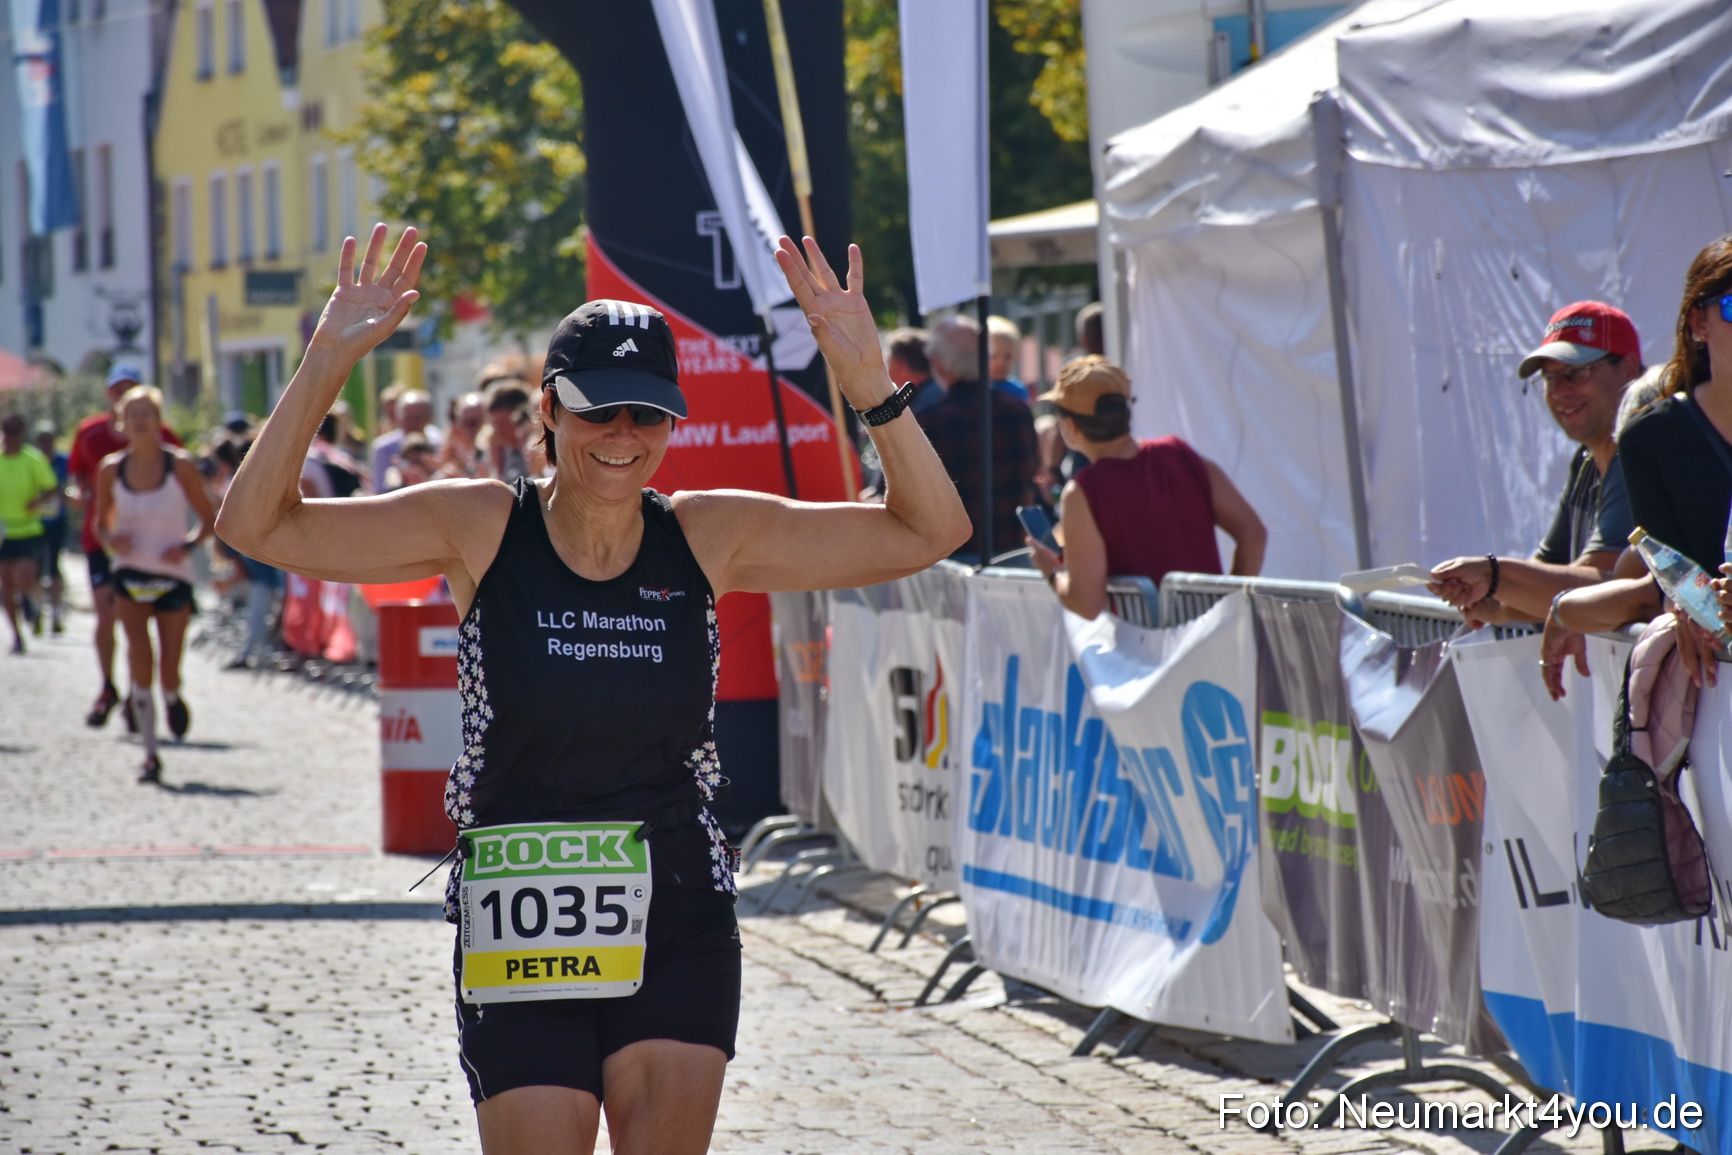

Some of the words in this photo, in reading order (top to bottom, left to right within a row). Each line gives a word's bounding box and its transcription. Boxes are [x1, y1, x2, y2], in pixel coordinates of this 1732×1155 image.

[714, 335, 763, 356] NEXT
[679, 357, 742, 375] YEARS
[722, 420, 830, 447] Laufport
[639, 586, 670, 601] PEPPEX
[537, 611, 576, 630] LLC
[582, 611, 666, 632] Marathon
[547, 638, 663, 663] Regensburg
[475, 832, 632, 873] BOCK
[480, 885, 628, 941] 1035
[506, 956, 602, 980] PETRA
